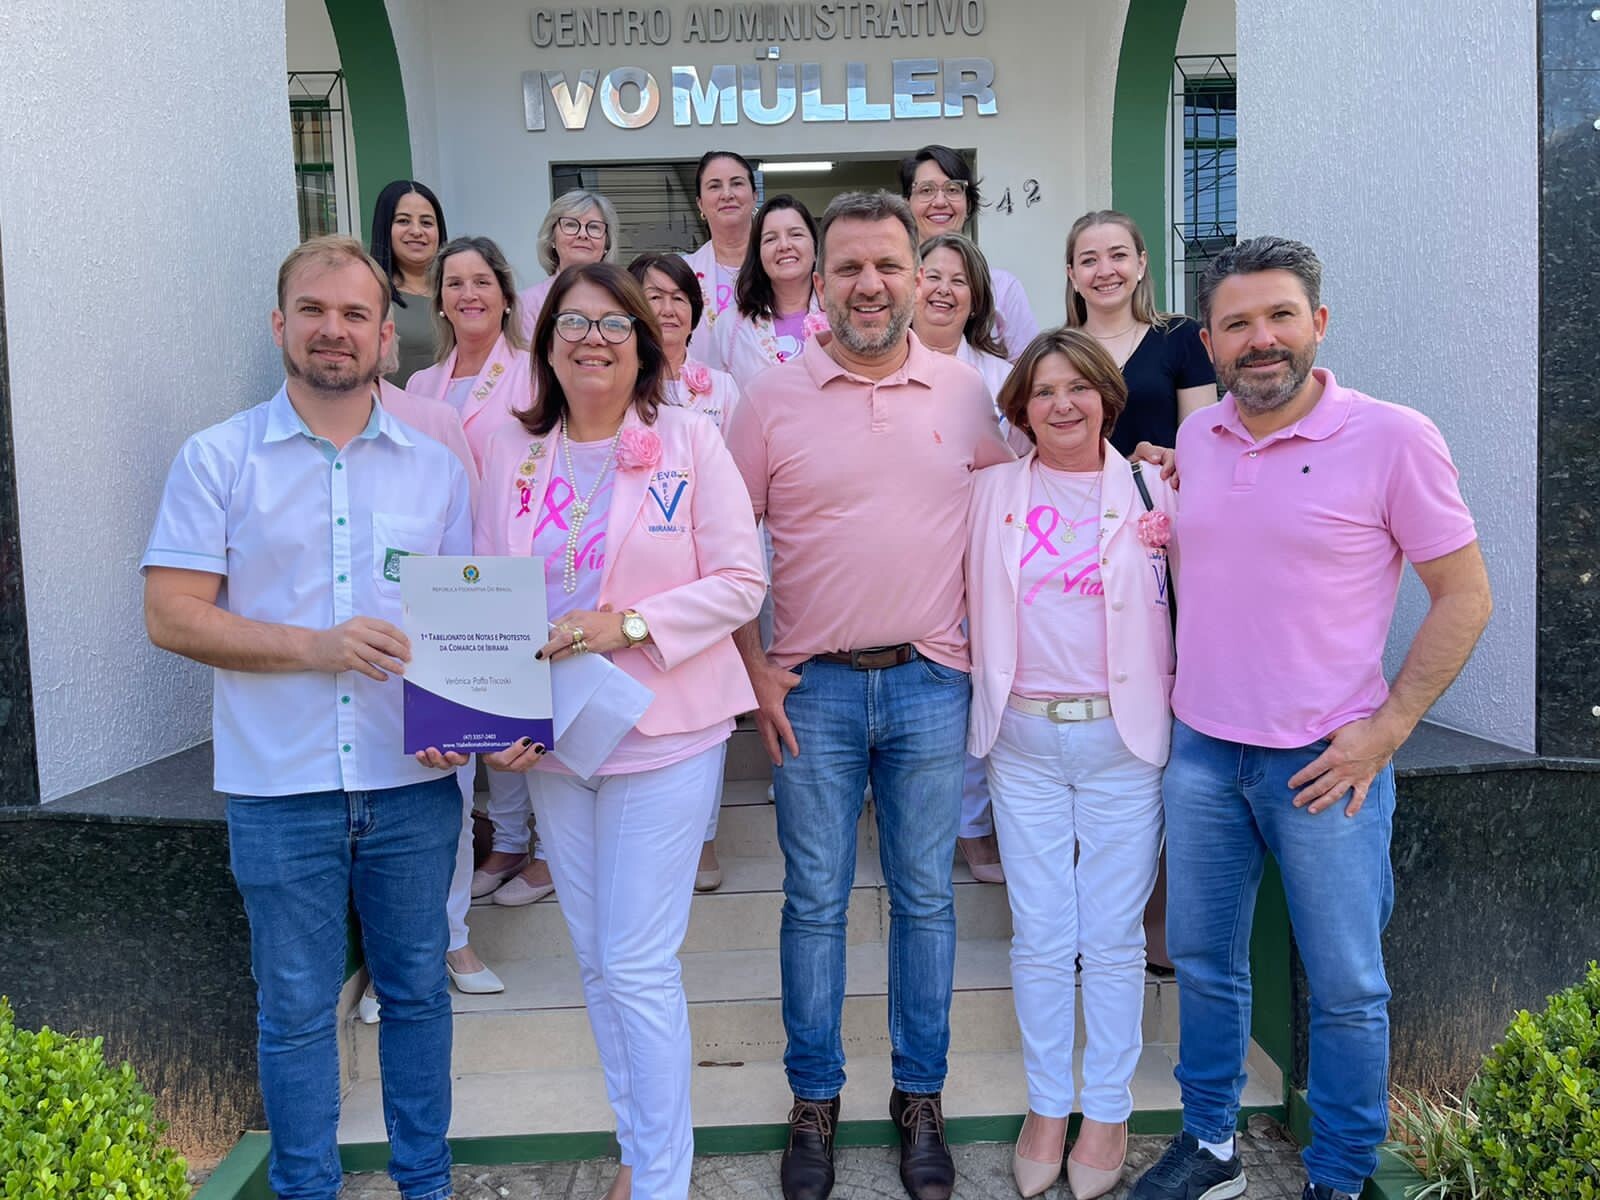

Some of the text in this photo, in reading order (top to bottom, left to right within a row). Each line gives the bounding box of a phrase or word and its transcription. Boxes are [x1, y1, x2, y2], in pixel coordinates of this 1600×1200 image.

[530, 0, 986, 48] CENTRO ADMINISTRATIVO
[521, 46, 999, 132] IVO MÜLLER
[439, 643, 448, 651] DA
[448, 643, 476, 652] COMARCA
[477, 643, 485, 652] DE
[467, 633, 475, 641] DE
[475, 633, 494, 641] NOTAS
[499, 633, 531, 641] PROTESTOS
